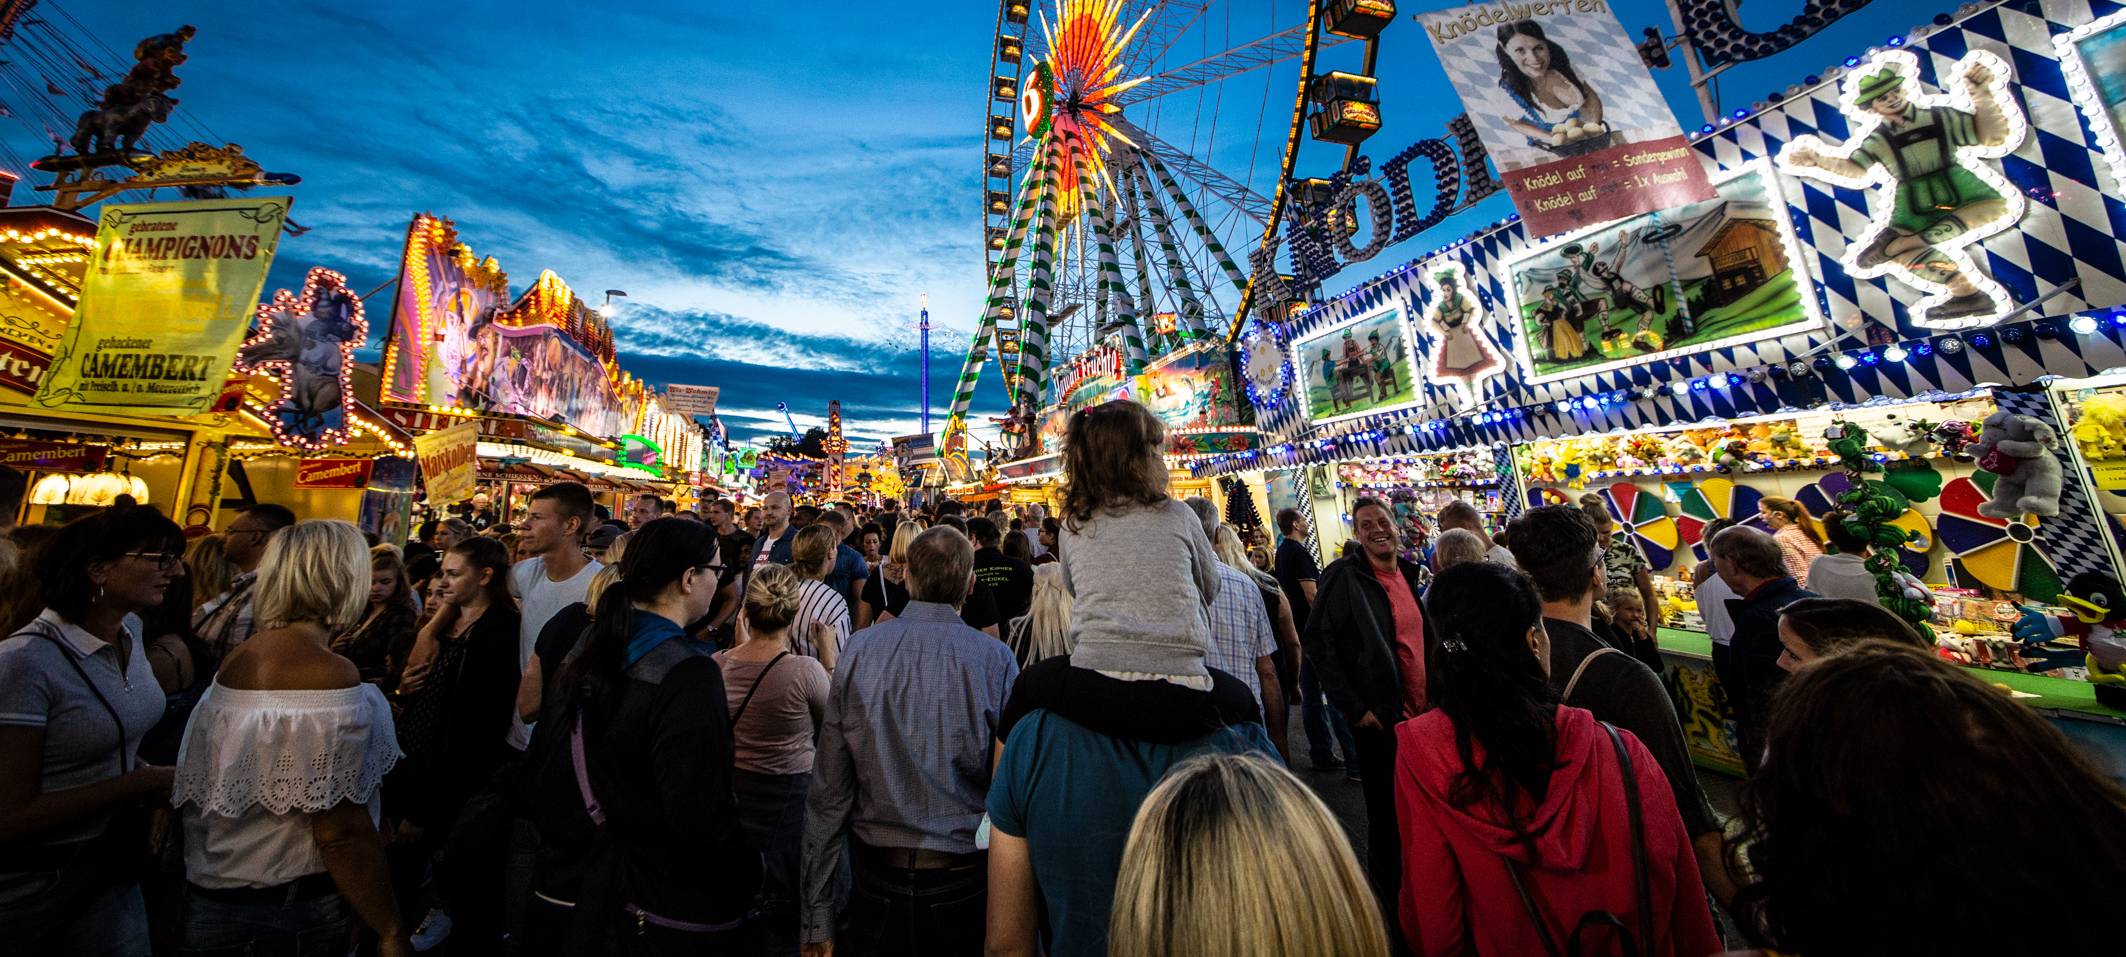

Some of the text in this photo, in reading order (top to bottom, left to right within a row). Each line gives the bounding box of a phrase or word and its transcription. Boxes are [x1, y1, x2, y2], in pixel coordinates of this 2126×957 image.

[1523, 170, 1563, 191] Knödel
[1567, 164, 1586, 181] auf
[1623, 146, 1690, 168] Sondergewinn
[1534, 191, 1575, 213] Knödel
[1578, 184, 1598, 202] auf
[80, 353, 216, 381] CAMEMBERT
[0, 446, 86, 463] amembert
[421, 443, 476, 480] Maiskolben
[296, 461, 361, 484] Camembert
